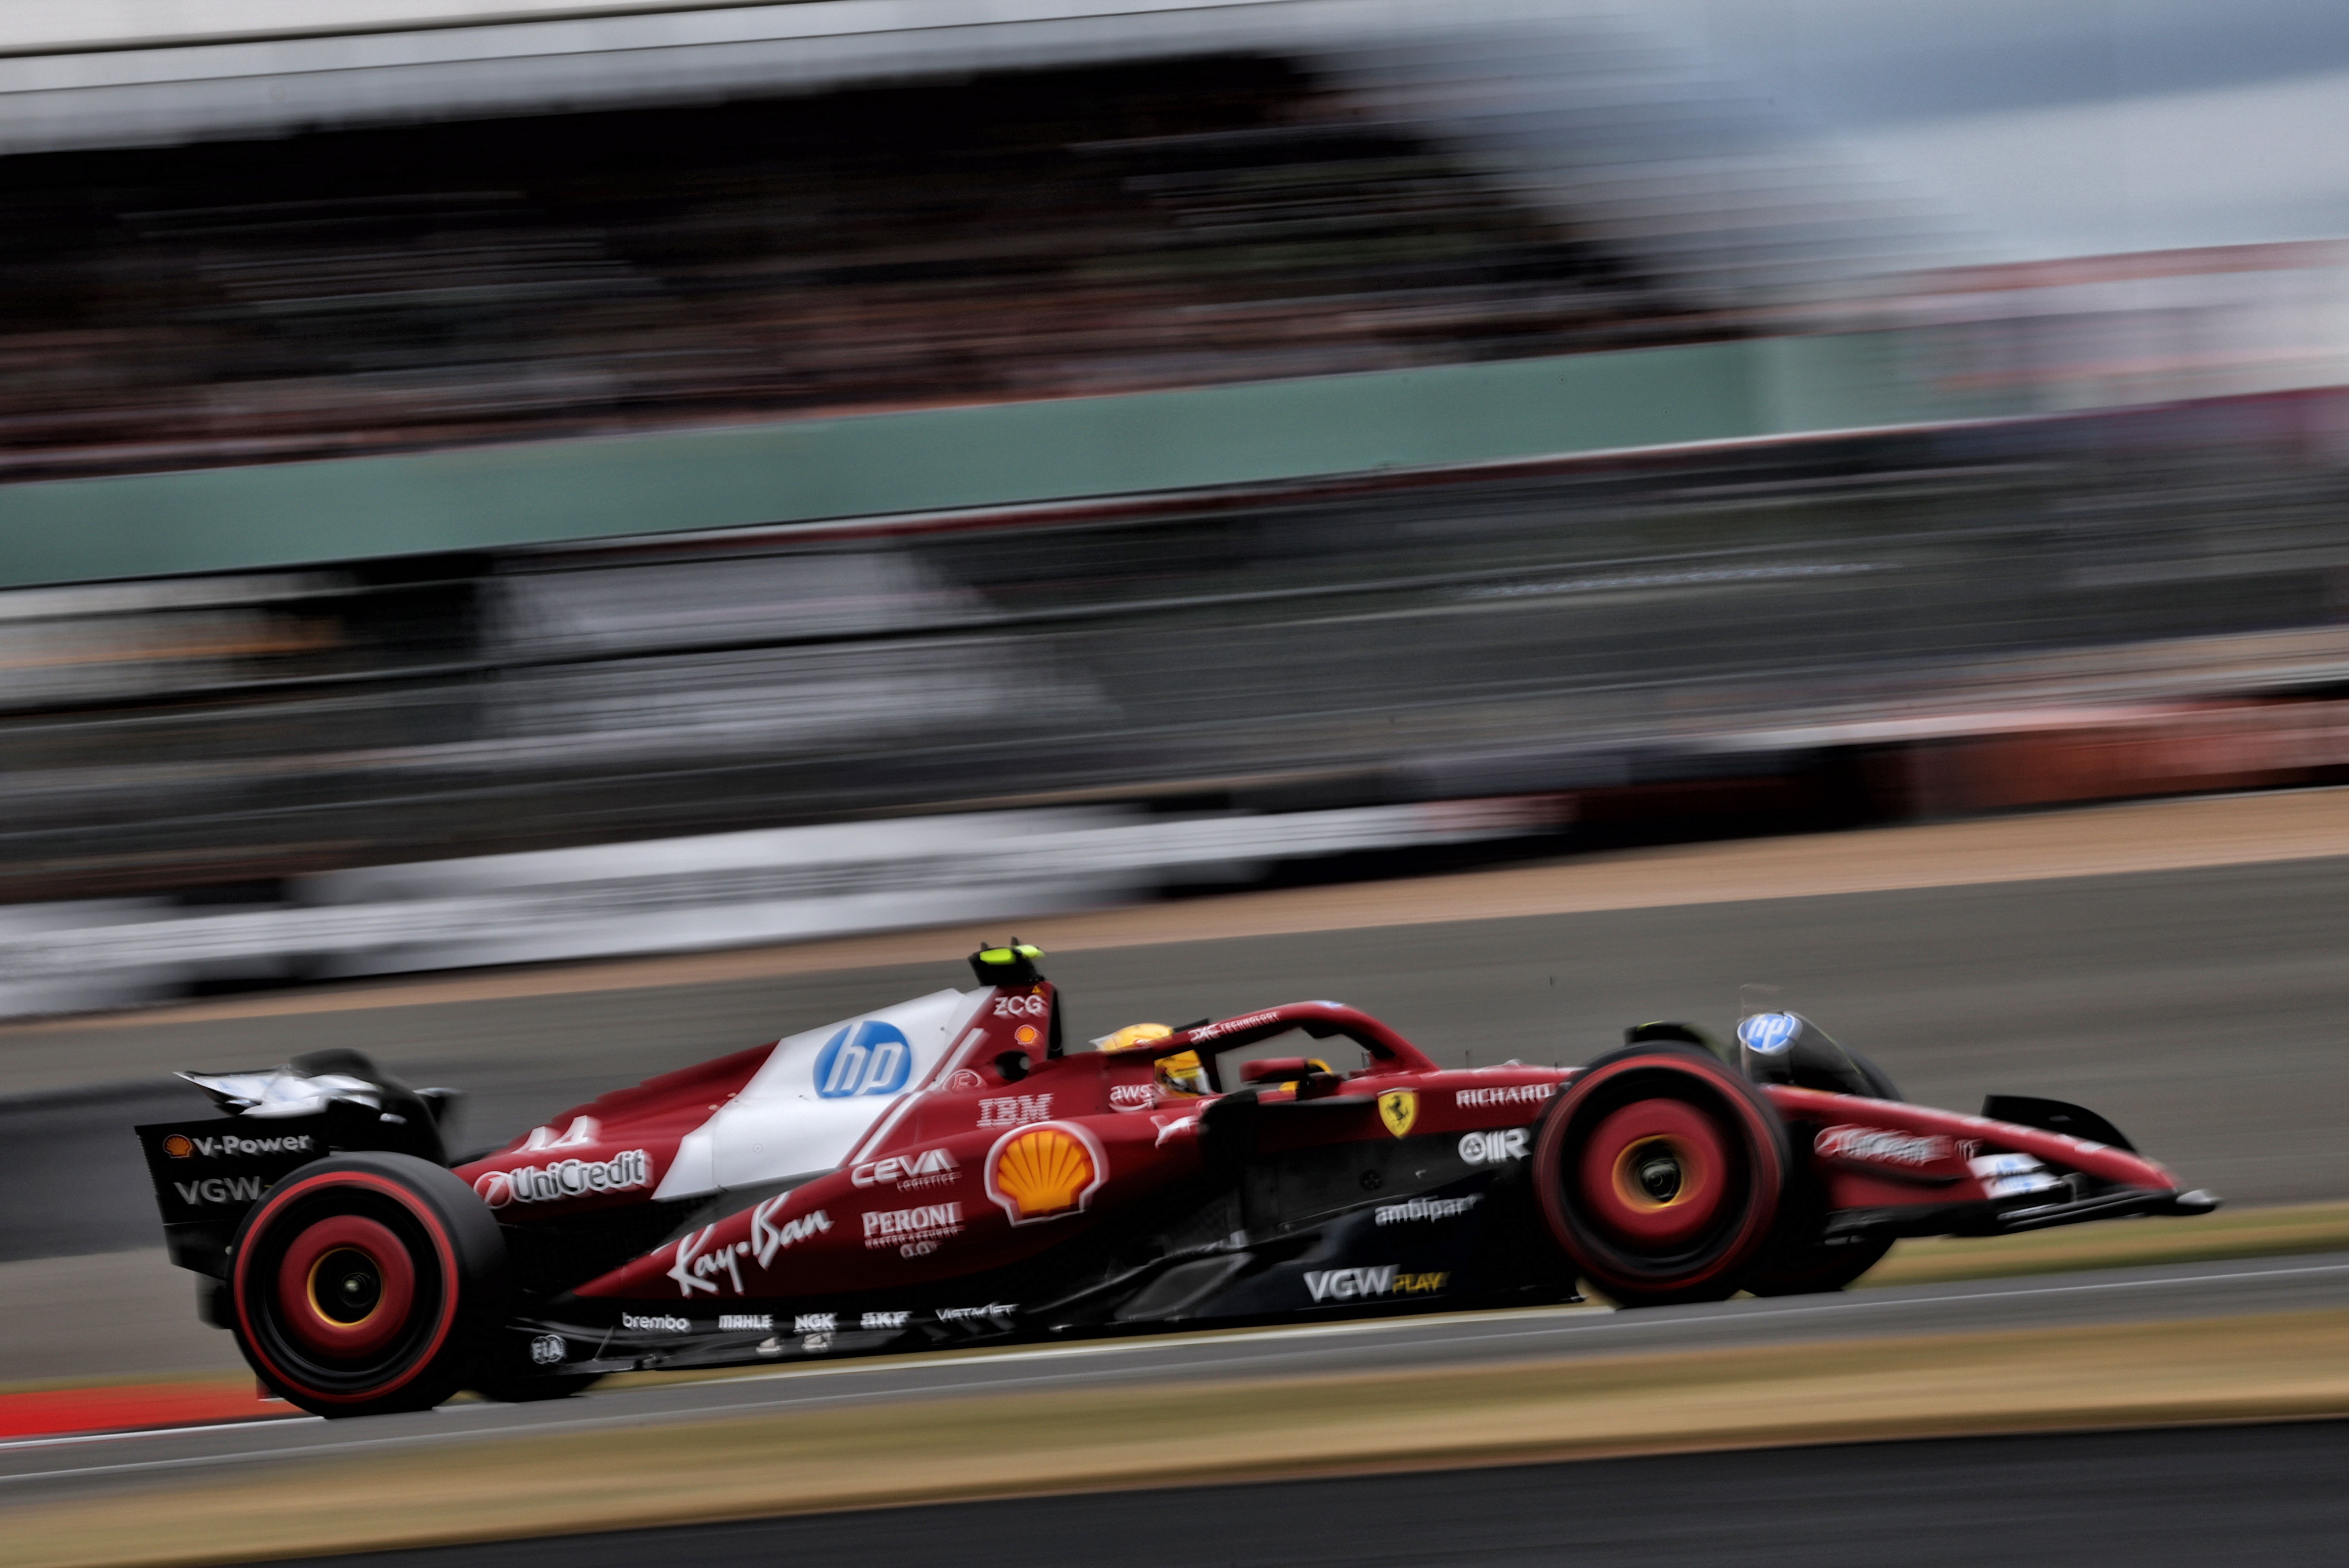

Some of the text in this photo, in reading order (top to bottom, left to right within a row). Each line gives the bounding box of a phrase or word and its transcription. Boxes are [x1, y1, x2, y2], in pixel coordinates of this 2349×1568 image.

[1220, 1011, 1280, 1034] TECHNOLOGY
[1747, 1014, 1785, 1050] hp
[822, 1020, 903, 1096] hp
[1109, 1083, 1154, 1103] aws
[1456, 1082, 1556, 1108] RICHARD
[976, 1093, 1054, 1128] IBM
[192, 1135, 314, 1157] V-Power
[510, 1149, 648, 1202] UniCredit
[851, 1148, 959, 1189] CEVA
[174, 1176, 260, 1206] VGW
[861, 1201, 964, 1239] PERONI
[1303, 1264, 1450, 1303] VGW PLAY
[622, 1312, 691, 1333] brembo
[719, 1314, 773, 1331] MAHLE
[794, 1313, 837, 1332] NGK
[860, 1311, 912, 1329] SKF
[531, 1340, 563, 1359] FIA
